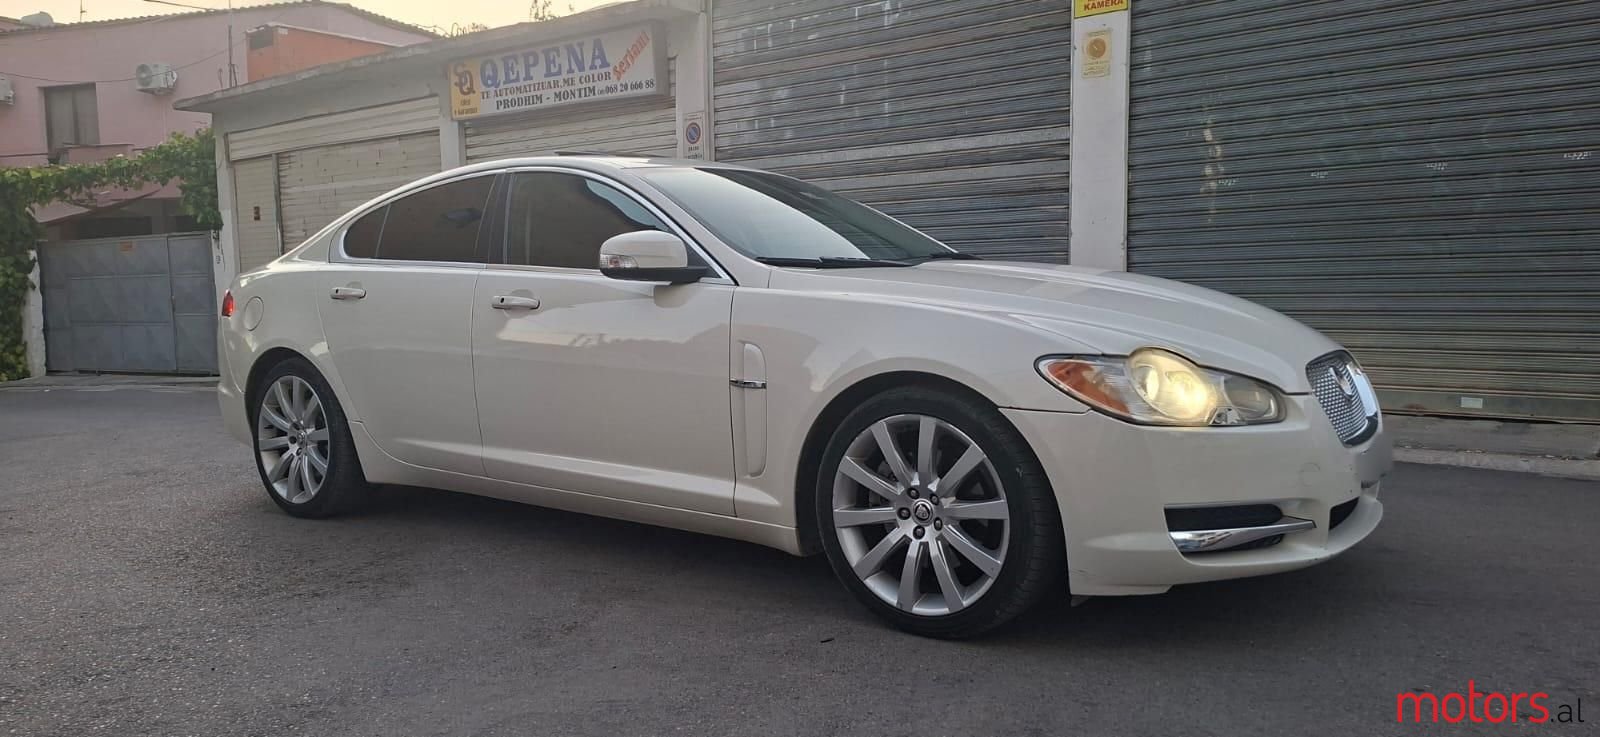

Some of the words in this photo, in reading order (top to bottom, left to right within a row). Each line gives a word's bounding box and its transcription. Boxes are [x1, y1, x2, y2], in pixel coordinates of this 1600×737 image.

[1084, 0, 1124, 10] KAMERA
[480, 38, 610, 88] QEPENA
[579, 71, 611, 85] COLOR
[496, 94, 543, 110] PRODHIM
[554, 86, 596, 102] MONTIM
